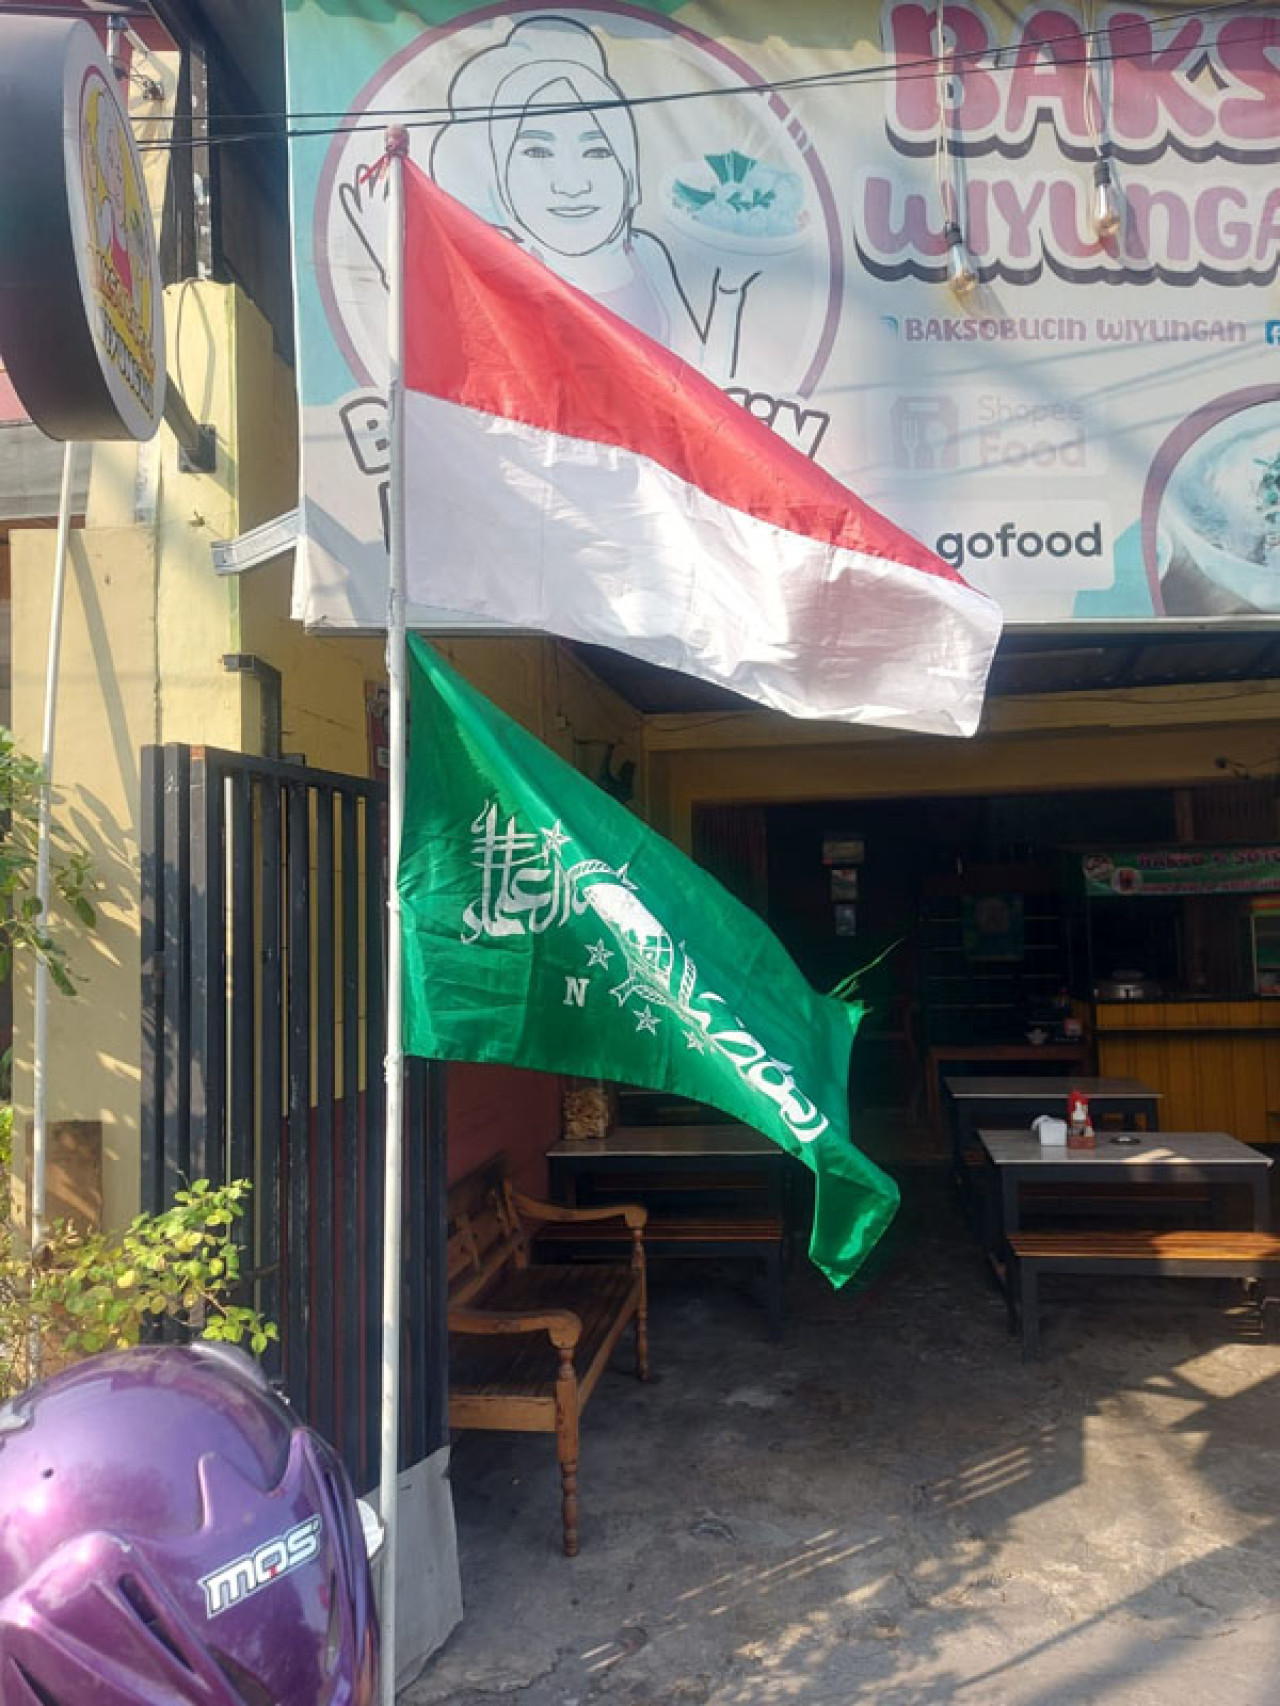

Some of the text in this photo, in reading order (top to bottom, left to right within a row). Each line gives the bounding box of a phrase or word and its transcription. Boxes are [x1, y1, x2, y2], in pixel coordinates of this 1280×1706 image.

[979, 426, 1086, 468] Food
[936, 522, 1101, 569] gofood
[563, 976, 590, 1007] N
